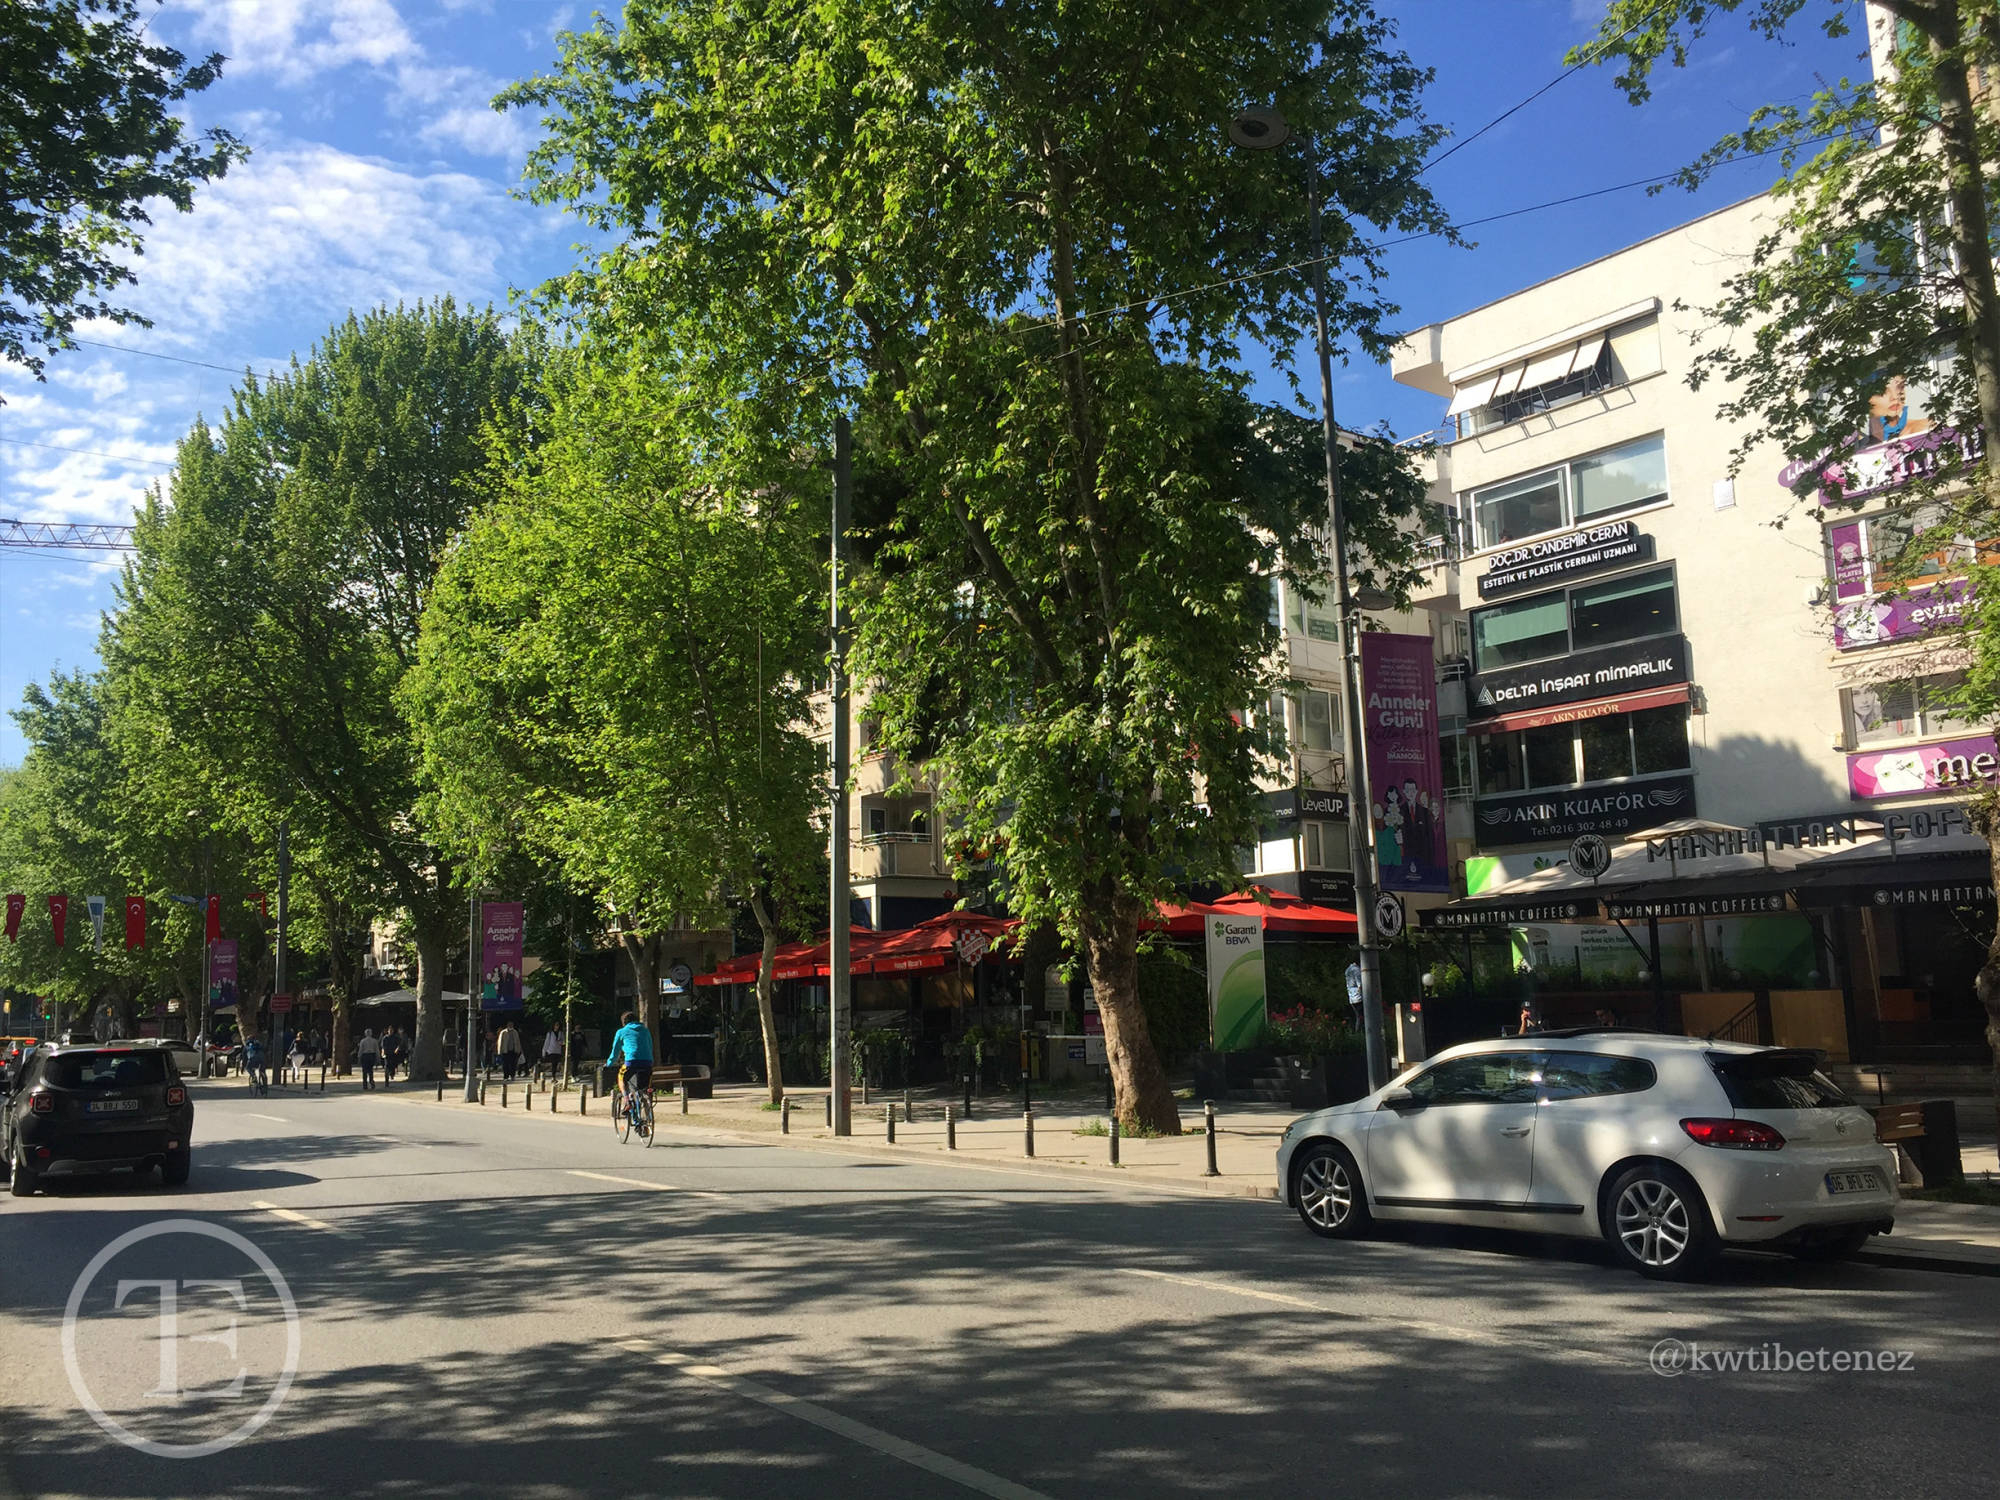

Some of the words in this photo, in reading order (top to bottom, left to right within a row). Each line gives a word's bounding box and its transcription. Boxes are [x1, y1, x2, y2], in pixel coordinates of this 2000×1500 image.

[1489, 549, 1532, 568] DOÇ.DR.
[1533, 533, 1587, 559] CANDEMİR
[1589, 522, 1628, 543] CERAN
[1483, 574, 1516, 589] ESTETİK
[1517, 570, 1527, 581] VE
[1529, 562, 1563, 578] PLASTİK
[1565, 552, 1601, 569] CERRAHİ
[1604, 543, 1638, 560] UZMANI
[1368, 692, 1432, 711] Anneler
[1496, 684, 1537, 702] DELTA
[1379, 711, 1424, 729] Günü
[1551, 711, 1575, 723] AKIN
[1577, 704, 1620, 720] KUAFÖR
[1301, 798, 1344, 814] LevelUP
[1514, 804, 1558, 822] AKIN
[1564, 792, 1645, 817] KUAFÖR
[1577, 822, 1596, 832] 302
[1615, 818, 1628, 828] 49
[1646, 818, 1857, 863] MANHATTAN
[1447, 910, 1515, 925] MANHATTAN
[1519, 905, 1564, 921] COFFEE
[1624, 898, 1707, 918] MANHATTAN
[1712, 897, 1766, 914] COFFEE
[1225, 924, 1257, 935] Garanti
[1225, 936, 1251, 945] BBVA
